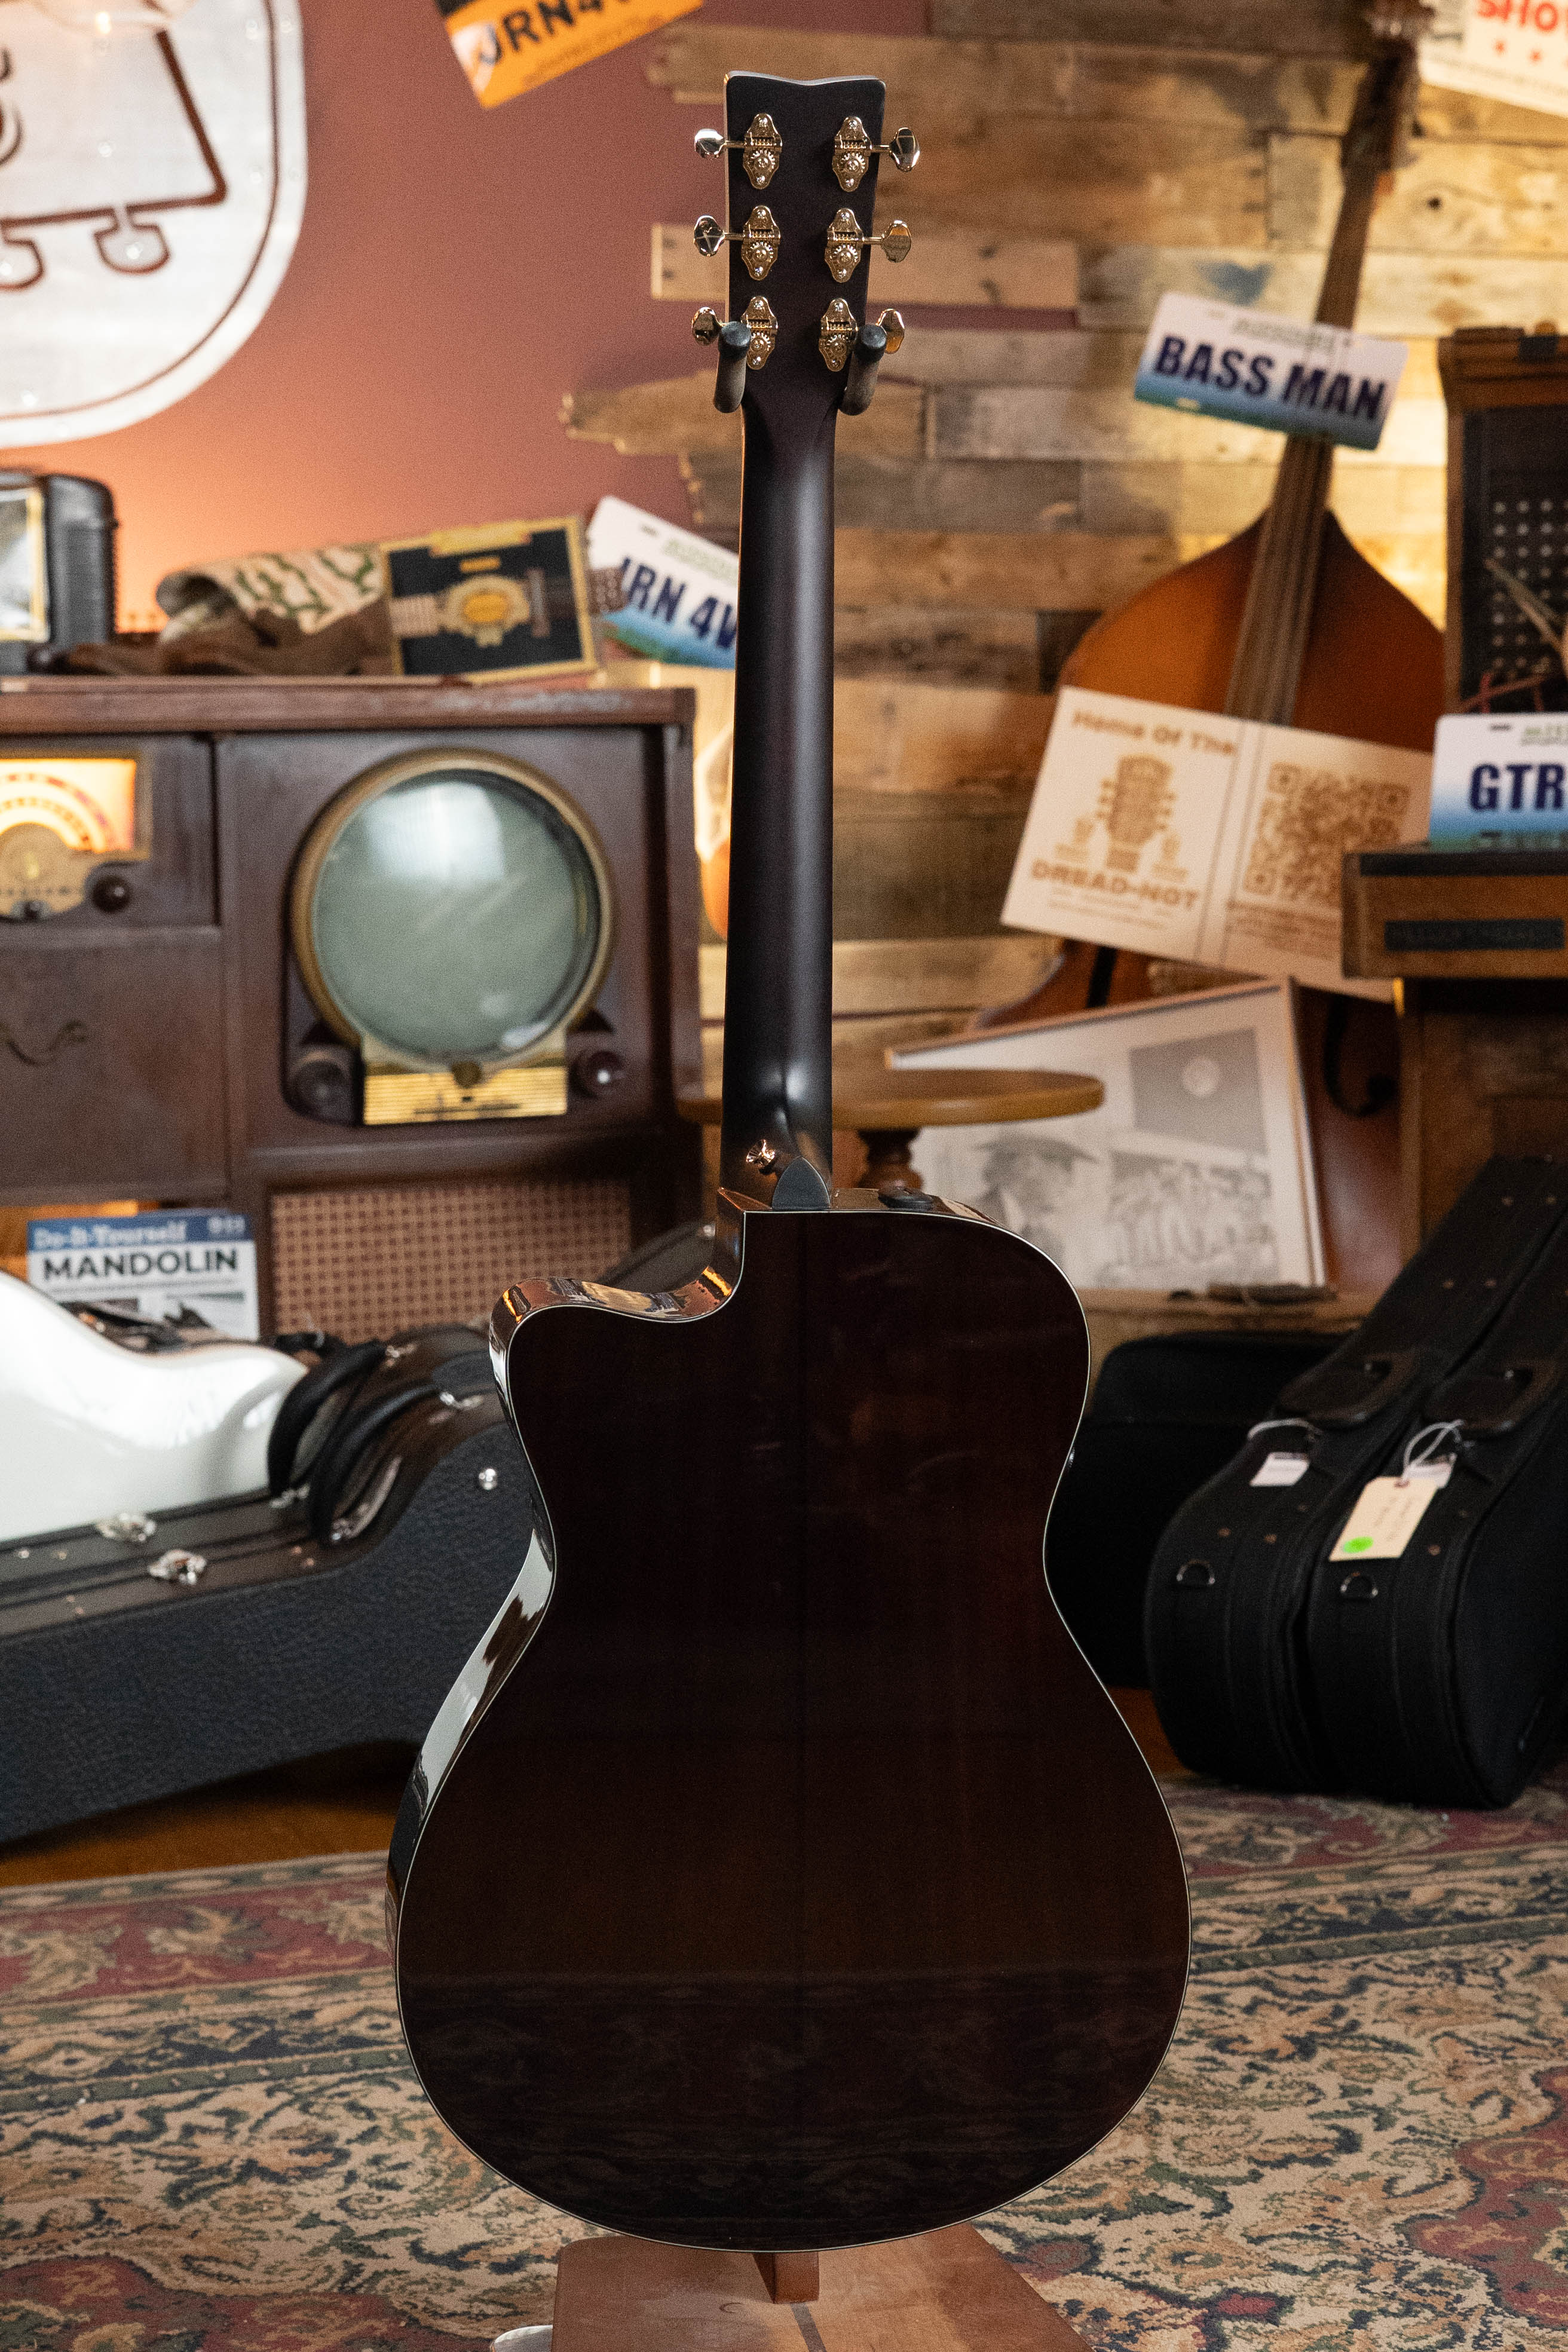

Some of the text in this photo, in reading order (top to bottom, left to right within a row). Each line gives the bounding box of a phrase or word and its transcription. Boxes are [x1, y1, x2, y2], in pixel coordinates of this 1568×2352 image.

[1154, 336, 1386, 419] BASS MAN
[1468, 762, 1567, 811] GTR
[43, 1249, 239, 1282] MANDOLIN
